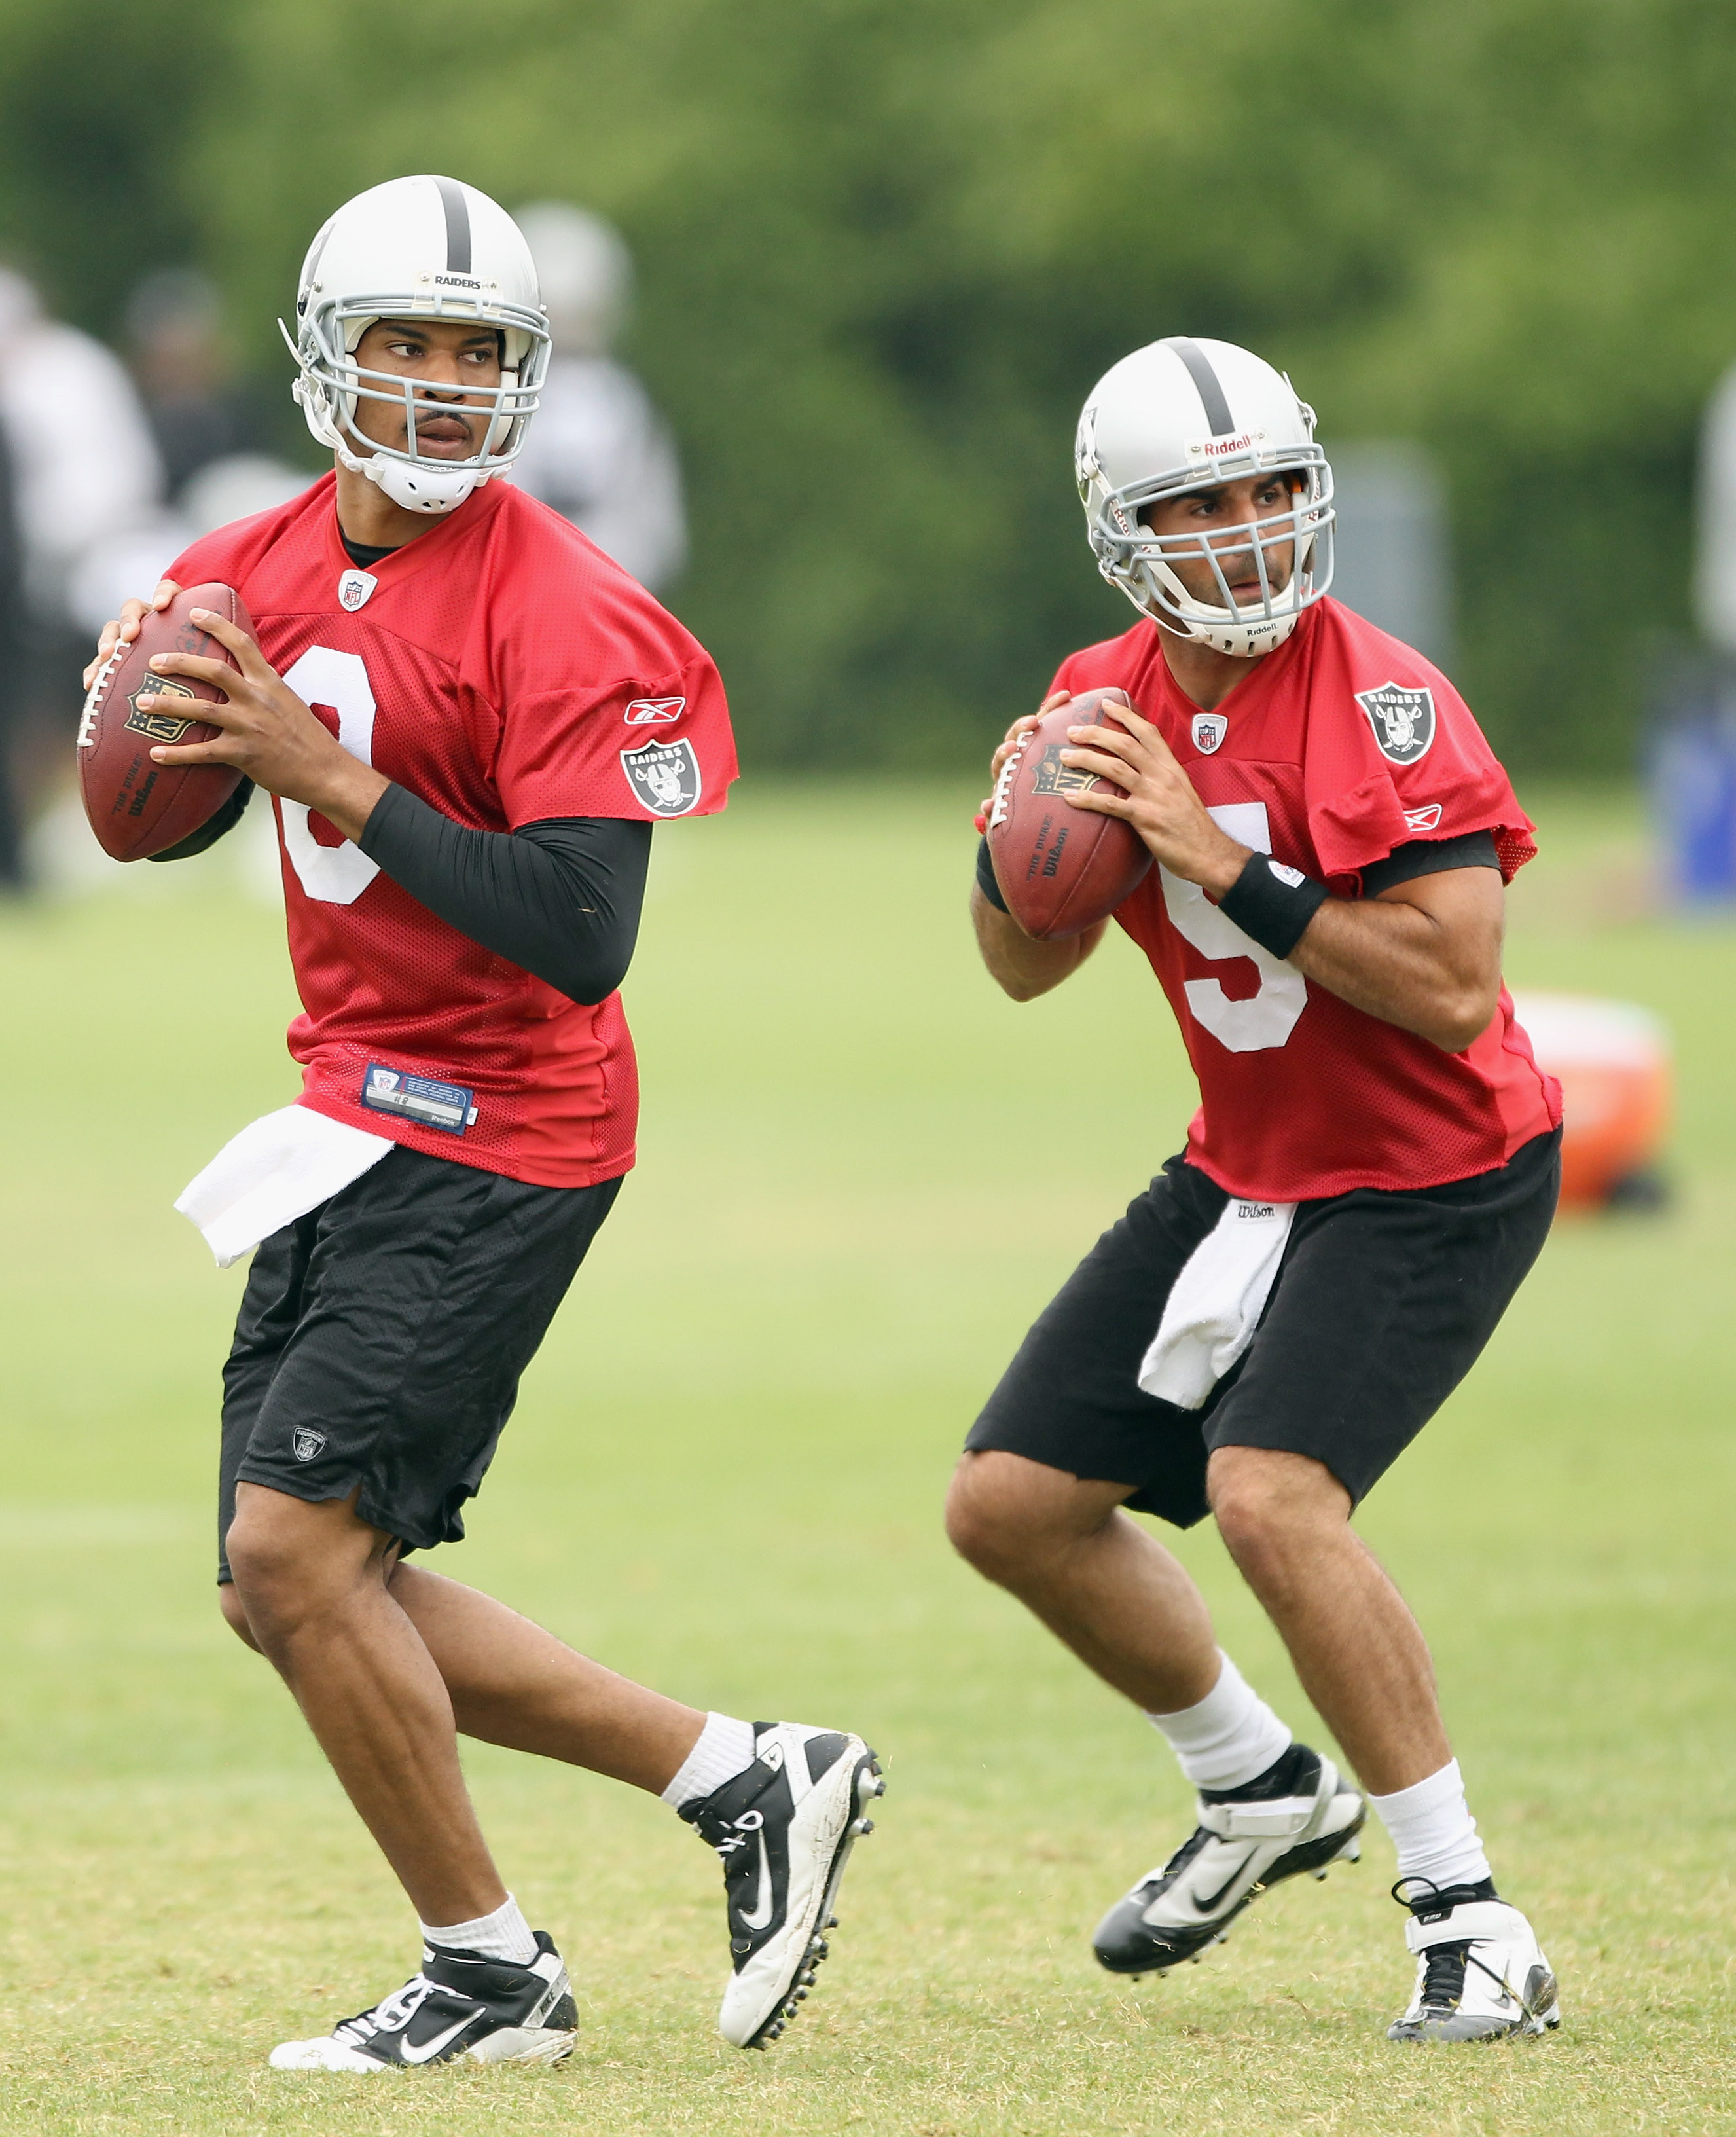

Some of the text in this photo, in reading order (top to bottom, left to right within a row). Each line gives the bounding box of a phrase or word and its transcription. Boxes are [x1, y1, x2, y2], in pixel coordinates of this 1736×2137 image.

[435, 276, 480, 290] RAIDERS
[1204, 434, 1251, 456] Riddell
[345, 591, 359, 603] NFL
[1246, 623, 1276, 636] Riddell
[1367, 693, 1422, 704] RAIDERS
[1199, 735, 1216, 747] NFL
[629, 746, 682, 765] RAIDERS
[1042, 827, 1069, 877] Wilson
[1159, 801, 1309, 1053] 5
[431, 1114, 456, 1127] Reebok
[1238, 1205, 1275, 1218] Wilson
[298, 1445, 312, 1456] NFL
